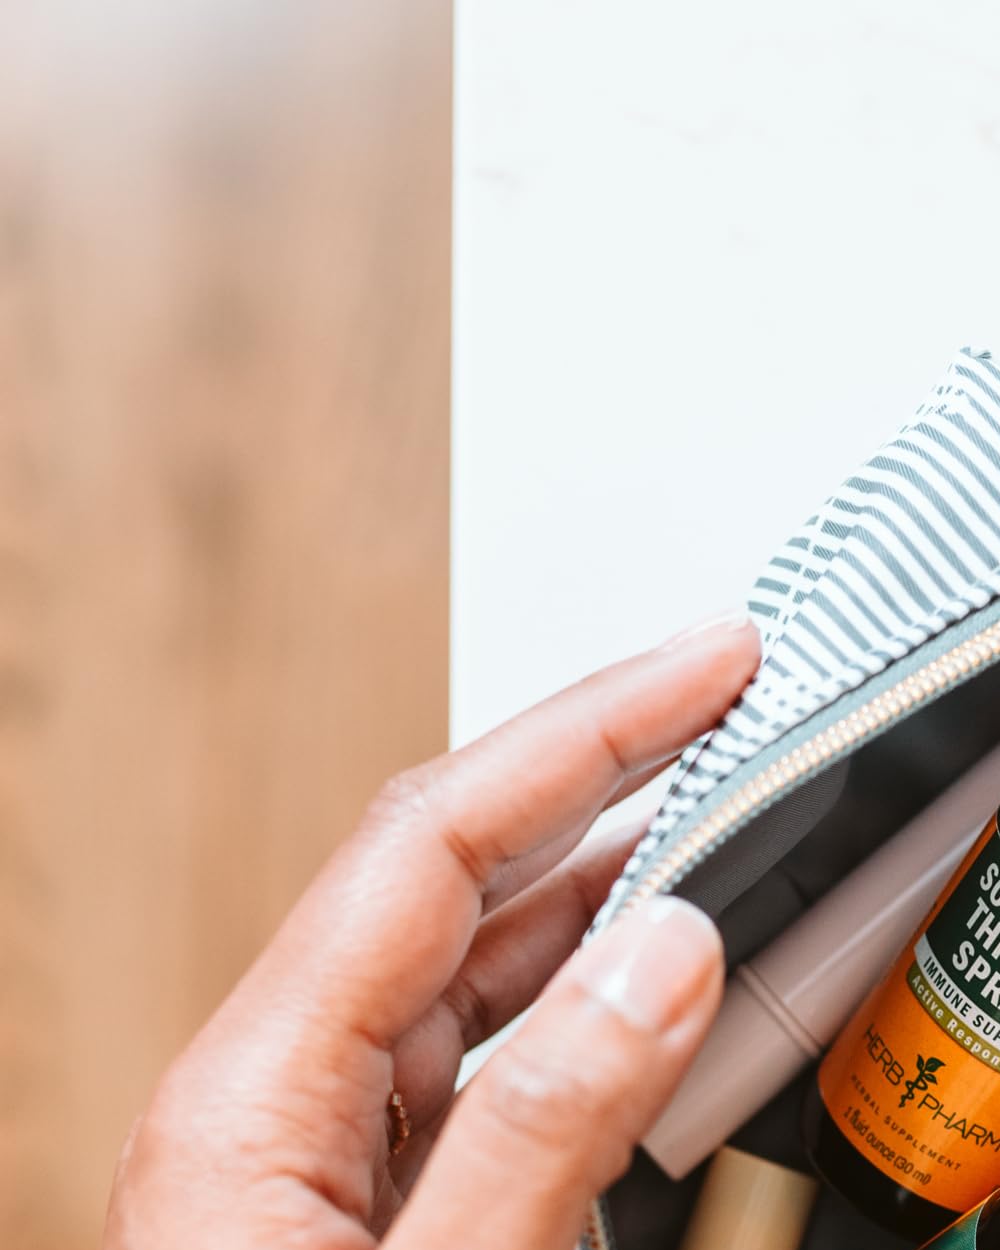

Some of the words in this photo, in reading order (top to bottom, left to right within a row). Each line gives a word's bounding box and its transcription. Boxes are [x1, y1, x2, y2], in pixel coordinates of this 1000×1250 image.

[912, 975, 944, 1019] Active
[923, 957, 972, 1017] IMMUNE
[864, 1024, 905, 1086] HERB
[866, 1133, 895, 1161] ounce
[893, 1153, 914, 1174] (30
[912, 1171, 932, 1186] ml)
[884, 1116, 961, 1171] SUPPLEMENT
